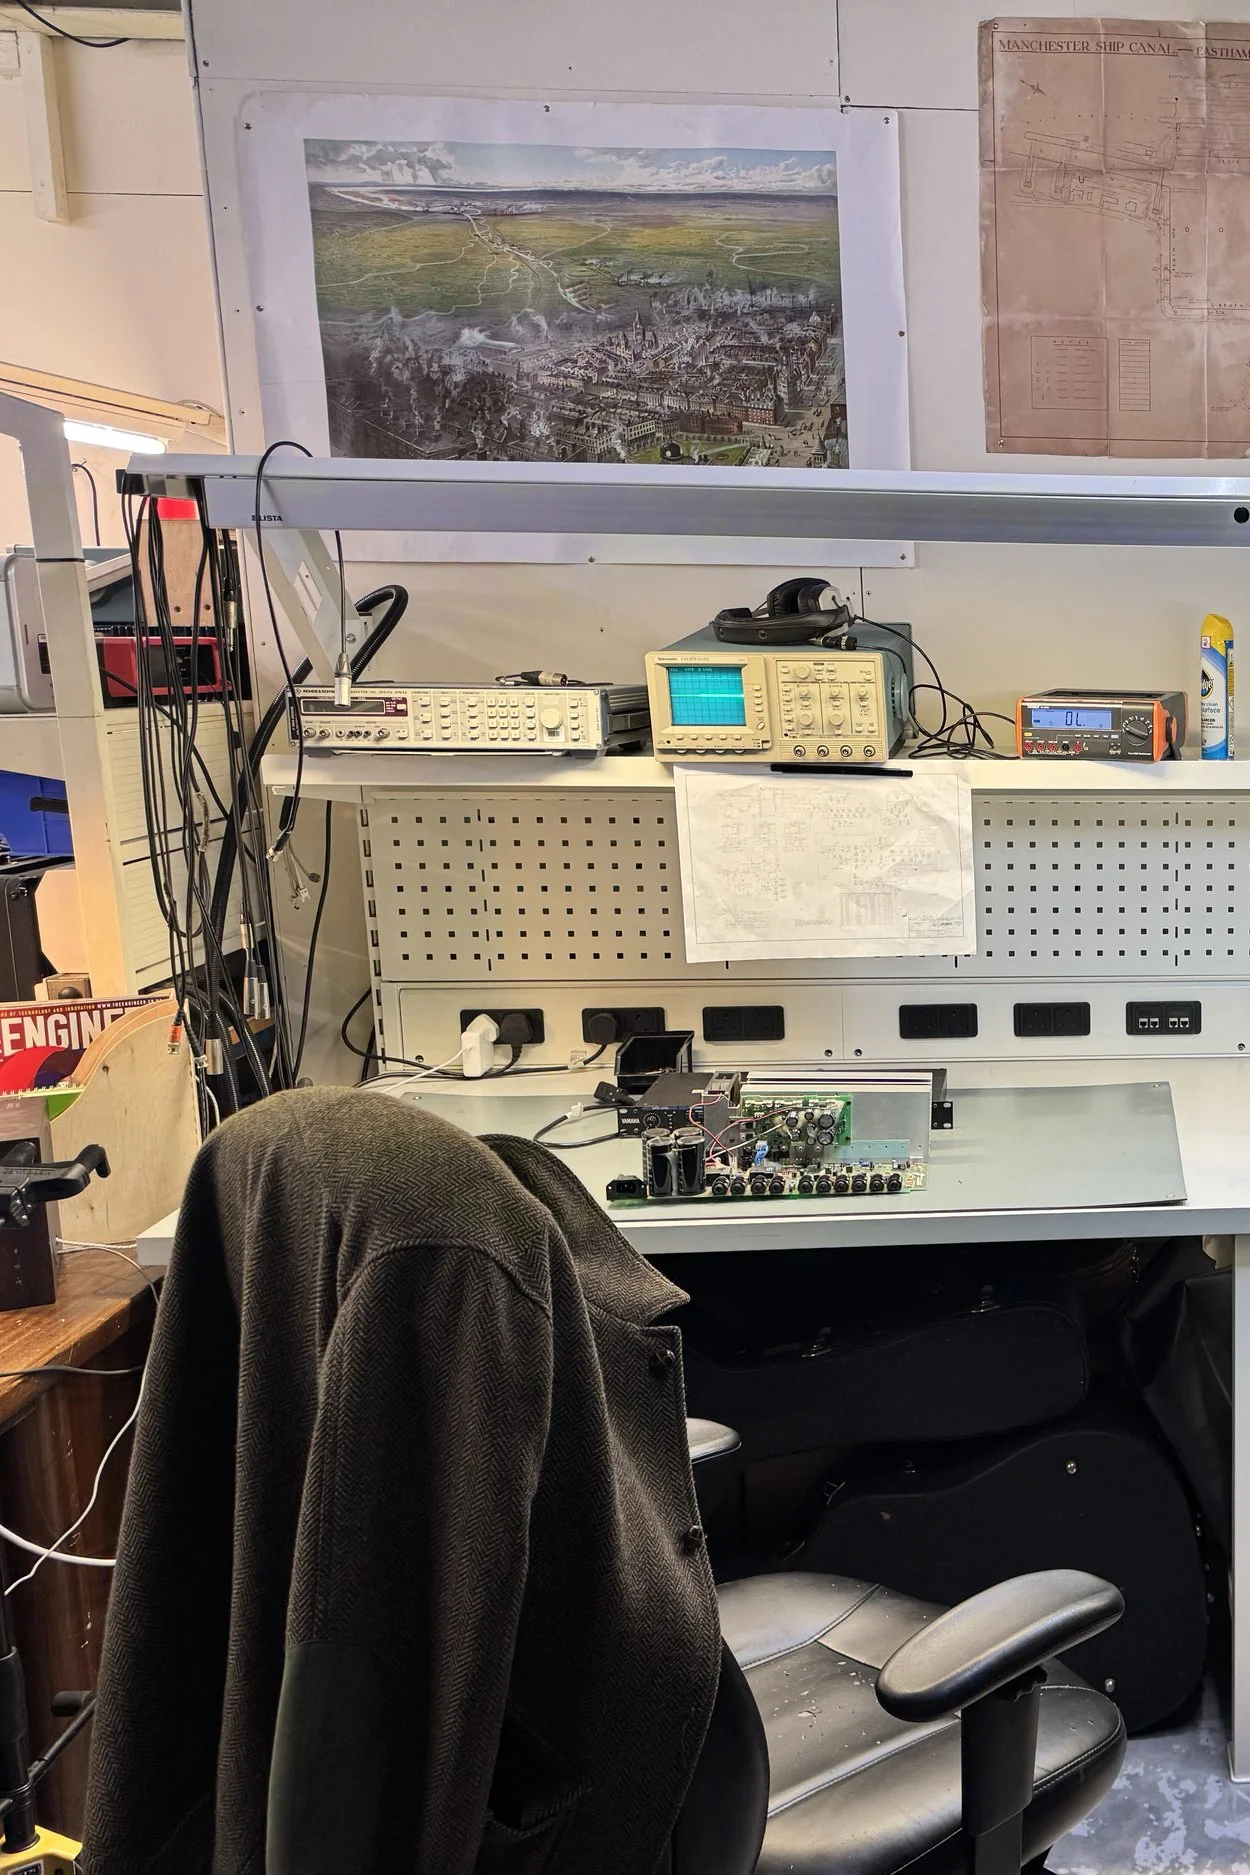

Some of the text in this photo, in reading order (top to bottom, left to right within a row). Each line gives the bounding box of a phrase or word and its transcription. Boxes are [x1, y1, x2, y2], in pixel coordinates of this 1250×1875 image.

[999, 39, 1090, 51] MANCHESTER
[1096, 40, 1124, 52] SHIP
[1, 1005, 134, 1057] ENGIN
